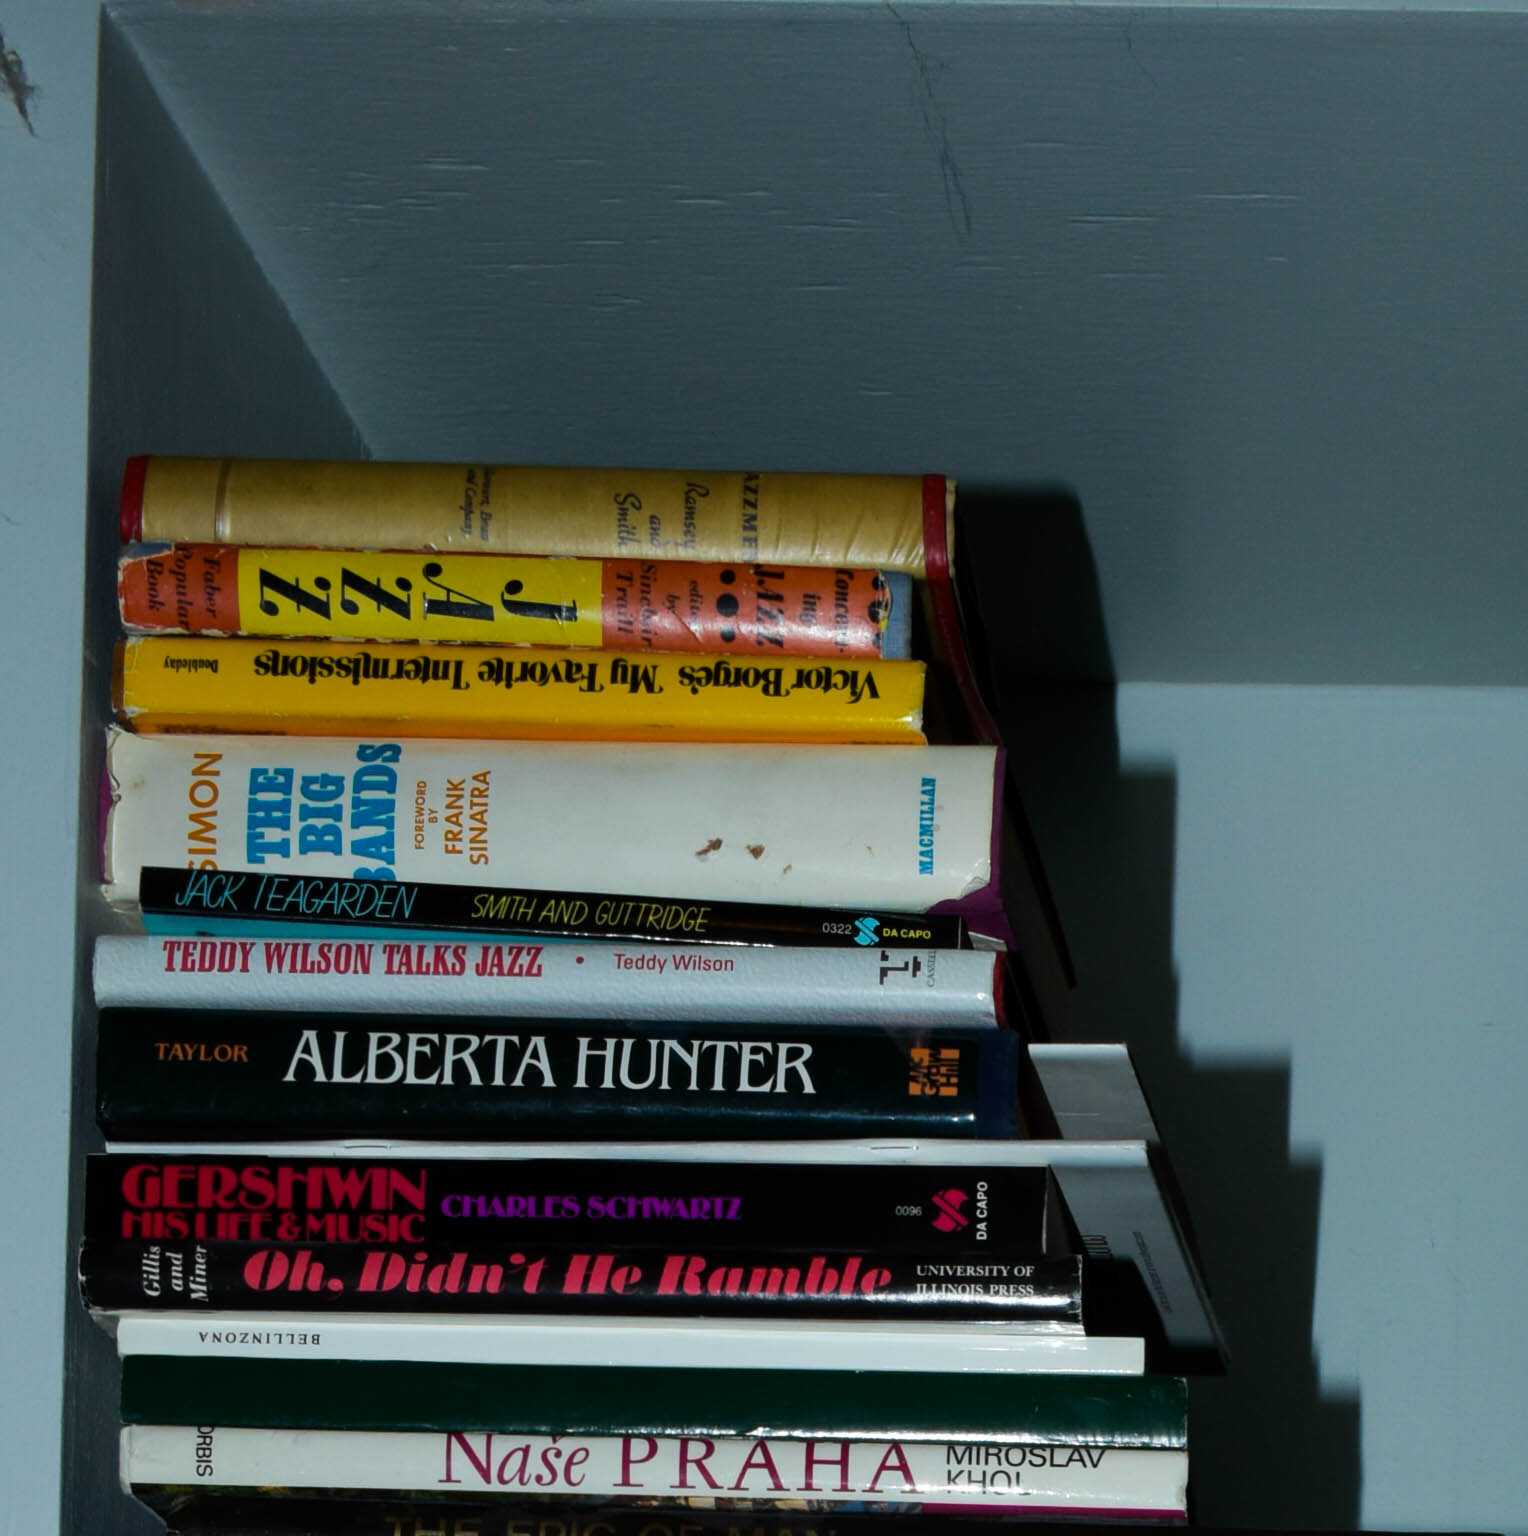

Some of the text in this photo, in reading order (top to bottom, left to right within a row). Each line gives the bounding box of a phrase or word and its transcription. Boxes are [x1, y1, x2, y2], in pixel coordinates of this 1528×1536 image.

[164, 656, 218, 673] Doubleday
[254, 649, 880, 704] Victor Borge's My Favorite Intermissions
[415, 781, 427, 849] FOREWORD
[428, 808, 438, 824] BY
[444, 779, 465, 854] FRANK
[469, 770, 492, 865] SINATRA
[919, 777, 936, 875] MACMILLAN
[163, 940, 543, 977] TEDDY WILSON TALKS JAZZ
[614, 954, 734, 973] Teddy Wilson
[154, 1041, 249, 1063] TAYLOR
[281, 1030, 816, 1094] ALBERTA HUNTER
[895, 1204, 922, 1217] 0096
[916, 1264, 1034, 1278] UNIVERSITY OF
[199, 1332, 320, 1345] BELLINZONA
[438, 1431, 925, 1495] Naše PRAHA
